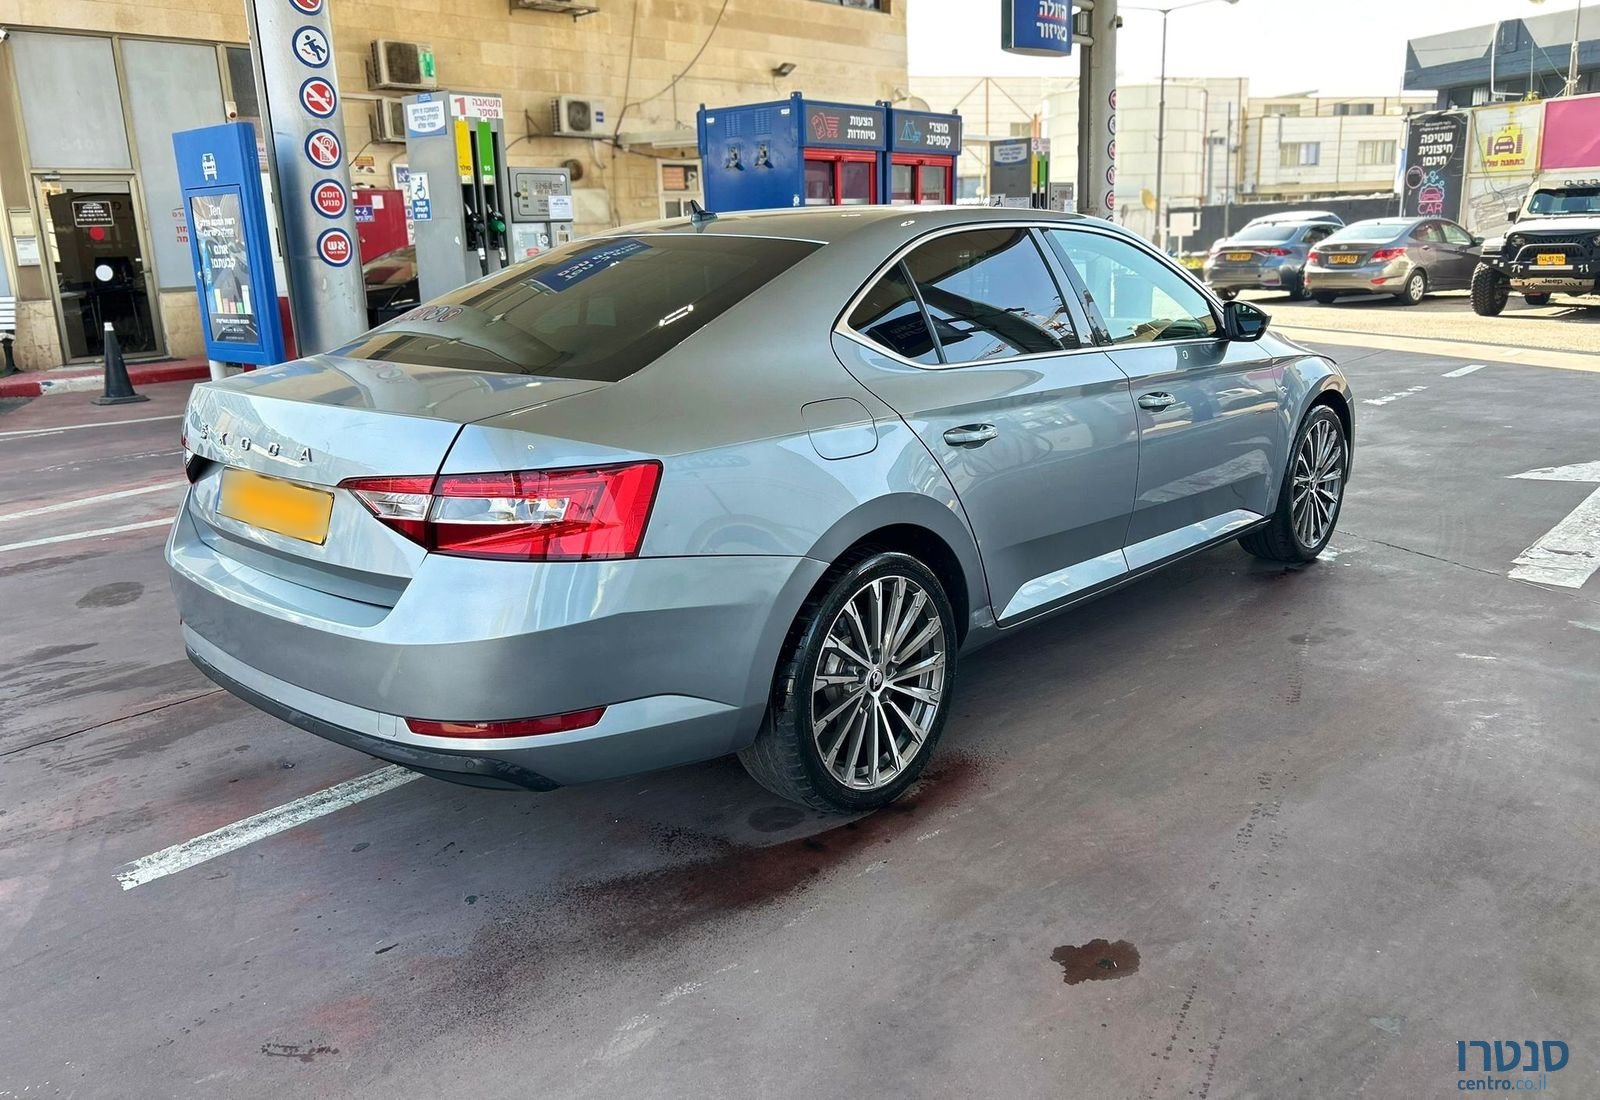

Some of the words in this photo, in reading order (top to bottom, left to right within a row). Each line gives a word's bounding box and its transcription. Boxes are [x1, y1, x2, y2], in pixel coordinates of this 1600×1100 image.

[455, 97, 466, 115] 1
[472, 98, 501, 107] משאבה
[477, 108, 499, 117] מספר
[849, 115, 873, 127] הצעות
[929, 122, 949, 133] מוצרי
[847, 129, 876, 140] מיוחדות
[1420, 132, 1453, 144] שטיפה
[926, 134, 951, 148] קמפינג
[1032, 140, 1039, 150] 3
[1417, 144, 1453, 155] חיצונית
[1422, 155, 1447, 166] חינם!
[322, 199, 340, 207] מנוע
[1417, 203, 1443, 214] CAR
[327, 241, 346, 250] אש
